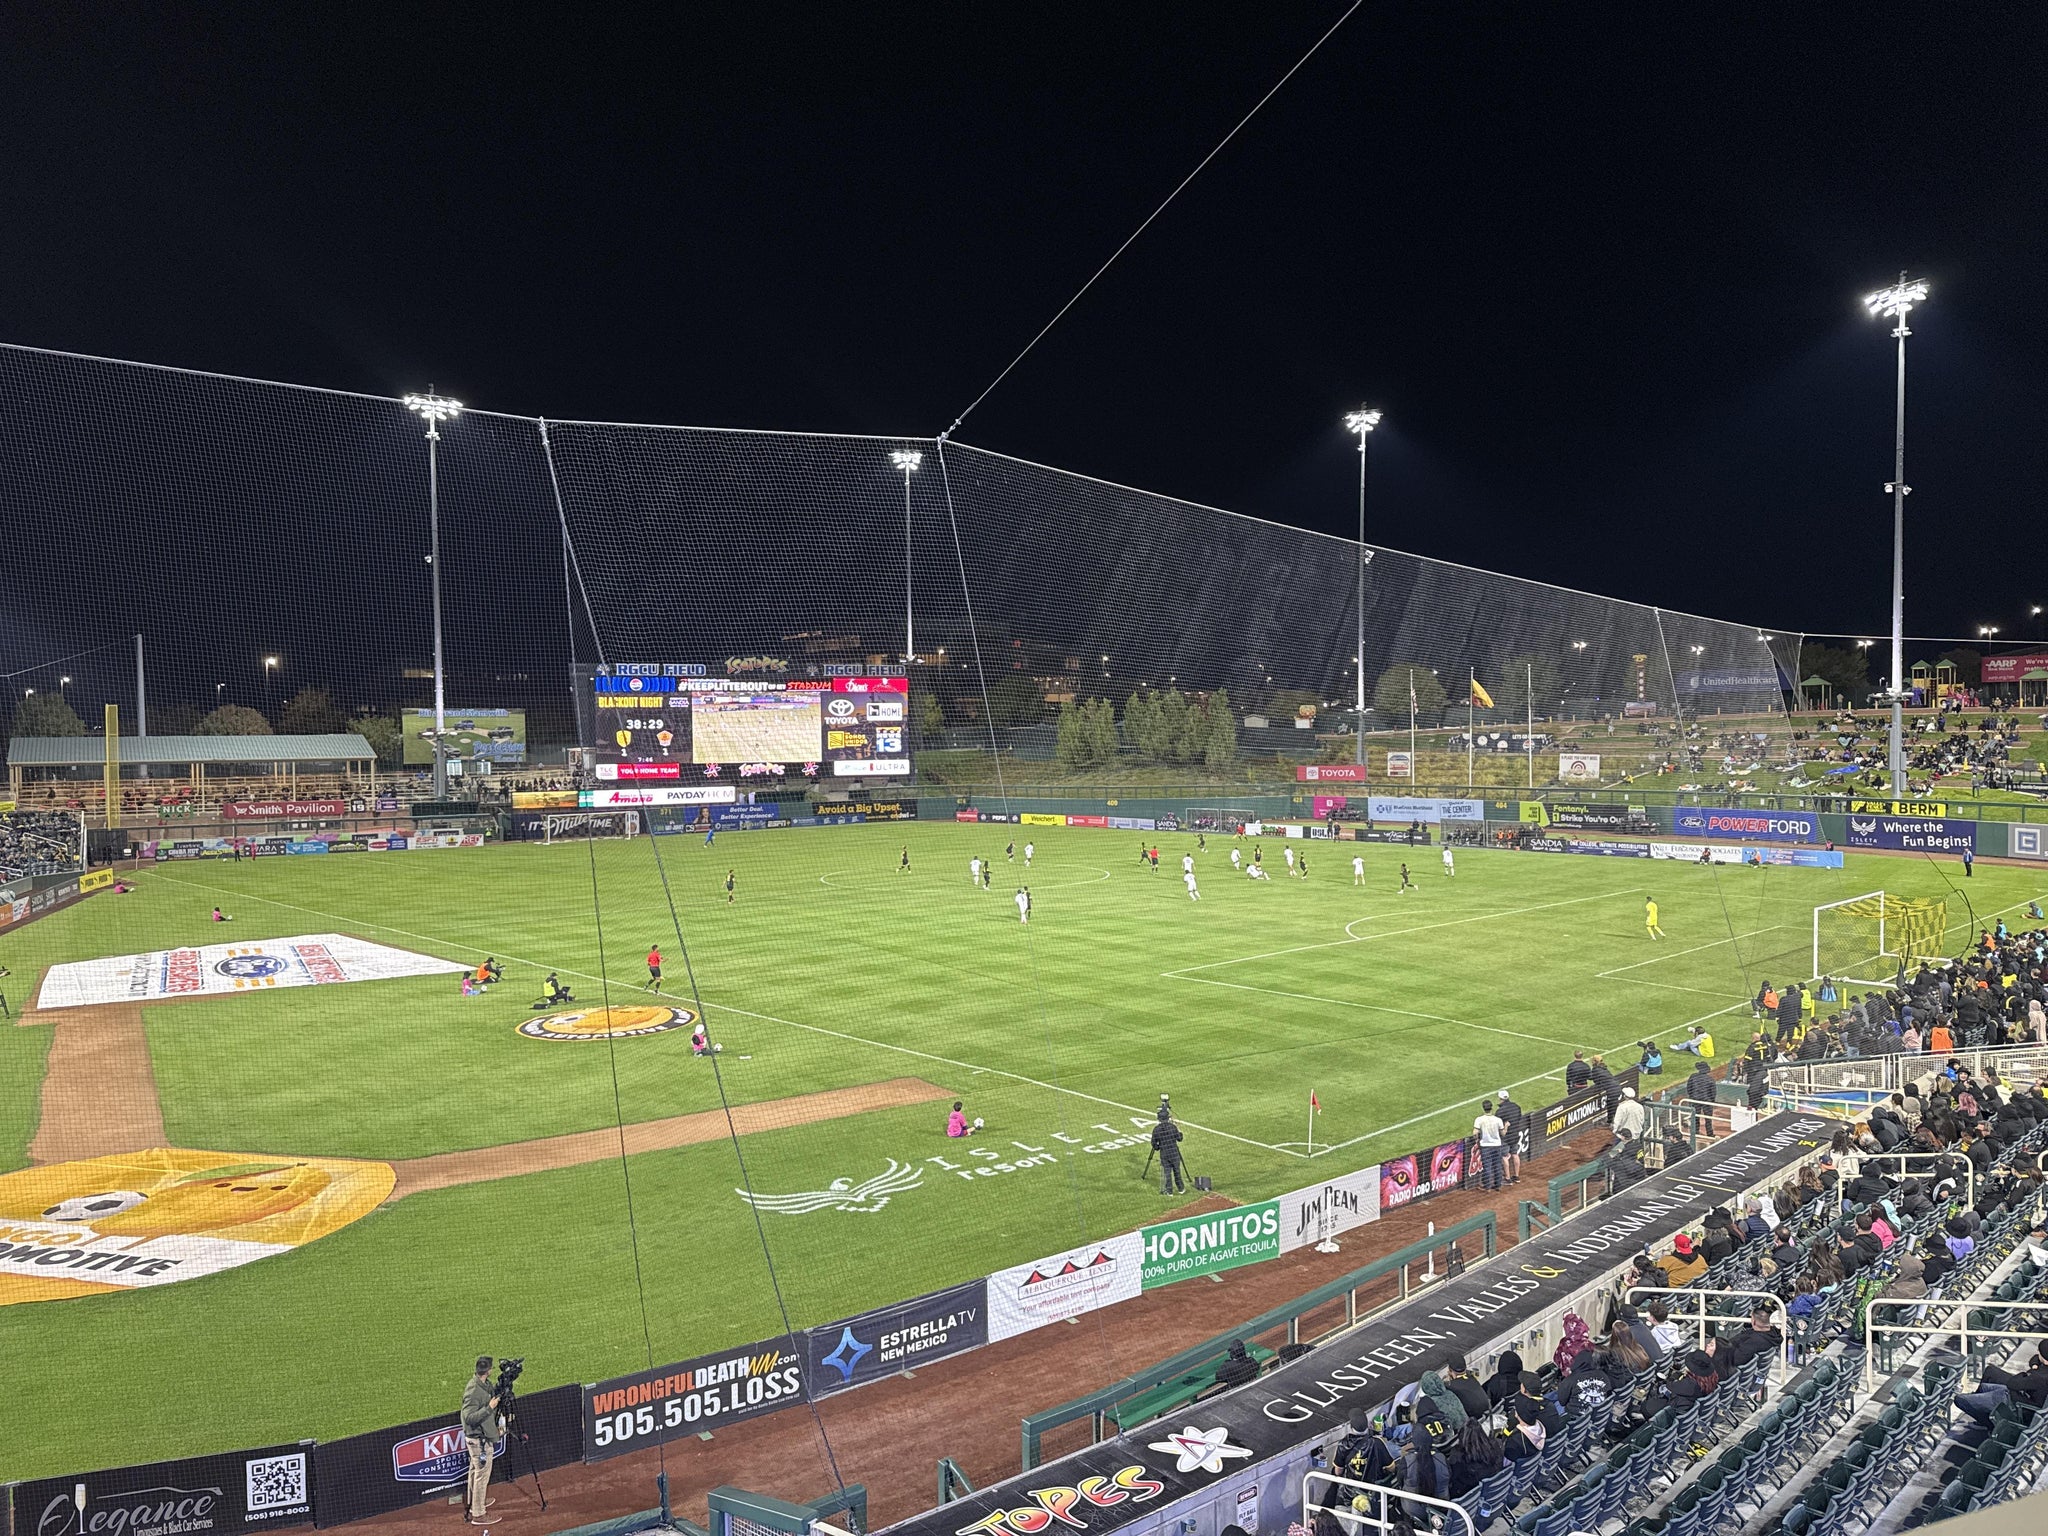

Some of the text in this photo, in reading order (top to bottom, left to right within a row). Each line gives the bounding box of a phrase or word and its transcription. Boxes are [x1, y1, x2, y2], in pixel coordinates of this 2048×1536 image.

[616, 663, 706, 676] RGCU FIELD
[823, 664, 906, 676] RGCU FIELD
[678, 682, 768, 691] #KEEPLITTEROUT
[787, 681, 832, 690] STADIUM
[1703, 677, 1778, 686] UnitedHealthcare
[640, 697, 663, 708] NIGHT
[626, 719, 664, 729] 38:29
[876, 738, 902, 752] 13
[621, 748, 669, 757] 1 1
[876, 763, 906, 771] ULTRA
[1321, 769, 1356, 777] TOYOTA
[667, 791, 706, 800] PAYDAY
[163, 805, 191, 813] NICK
[248, 803, 335, 815] Smith's Pavilion
[818, 805, 847, 814] Avoid
[856, 804, 872, 813] Big
[874, 803, 902, 812] Upset.
[1553, 805, 1590, 814] Fentanyl.
[1899, 803, 1939, 815] BERM
[589, 819, 612, 827] TIME
[1157, 820, 1177, 828] SANDIA
[1560, 814, 1584, 822] Strike
[1584, 815, 1609, 823] You're
[1682, 817, 1705, 827] Ford
[1883, 822, 1944, 833] Where the
[1530, 838, 1564, 848] SANDIA
[1903, 836, 1924, 847] Fun
[1928, 836, 1972, 849] Begins!
[1546, 1099, 1600, 1136] ARMY NATIONAL
[957, 1150, 1058, 1181] resort
[1389, 1172, 1458, 1205] RADIO LOBO 97.7 FM
[1296, 1195, 1321, 1237] JIM
[1140, 1209, 1278, 1265] HORNITOS
[1140, 1238, 1277, 1280] 100% PURO DE AGAVE TEQUILA
[1263, 1118, 1827, 1423] GLASHEEN, VALLES & INDERMAN, LLP INJURY LAWYERS
[1024, 1263, 1112, 1295] ALBUQUERQUE TENTS
[1039, 1294, 1069, 1309] affordable
[880, 1308, 976, 1349] ESTRELLA TV
[880, 1333, 947, 1362] NEW MEXICO
[245, 1506, 310, 1523] (505) 918-8002
[168, 1522, 183, 1533] Black
[183, 1520, 193, 1531] Car
[193, 1517, 214, 1529] Services
